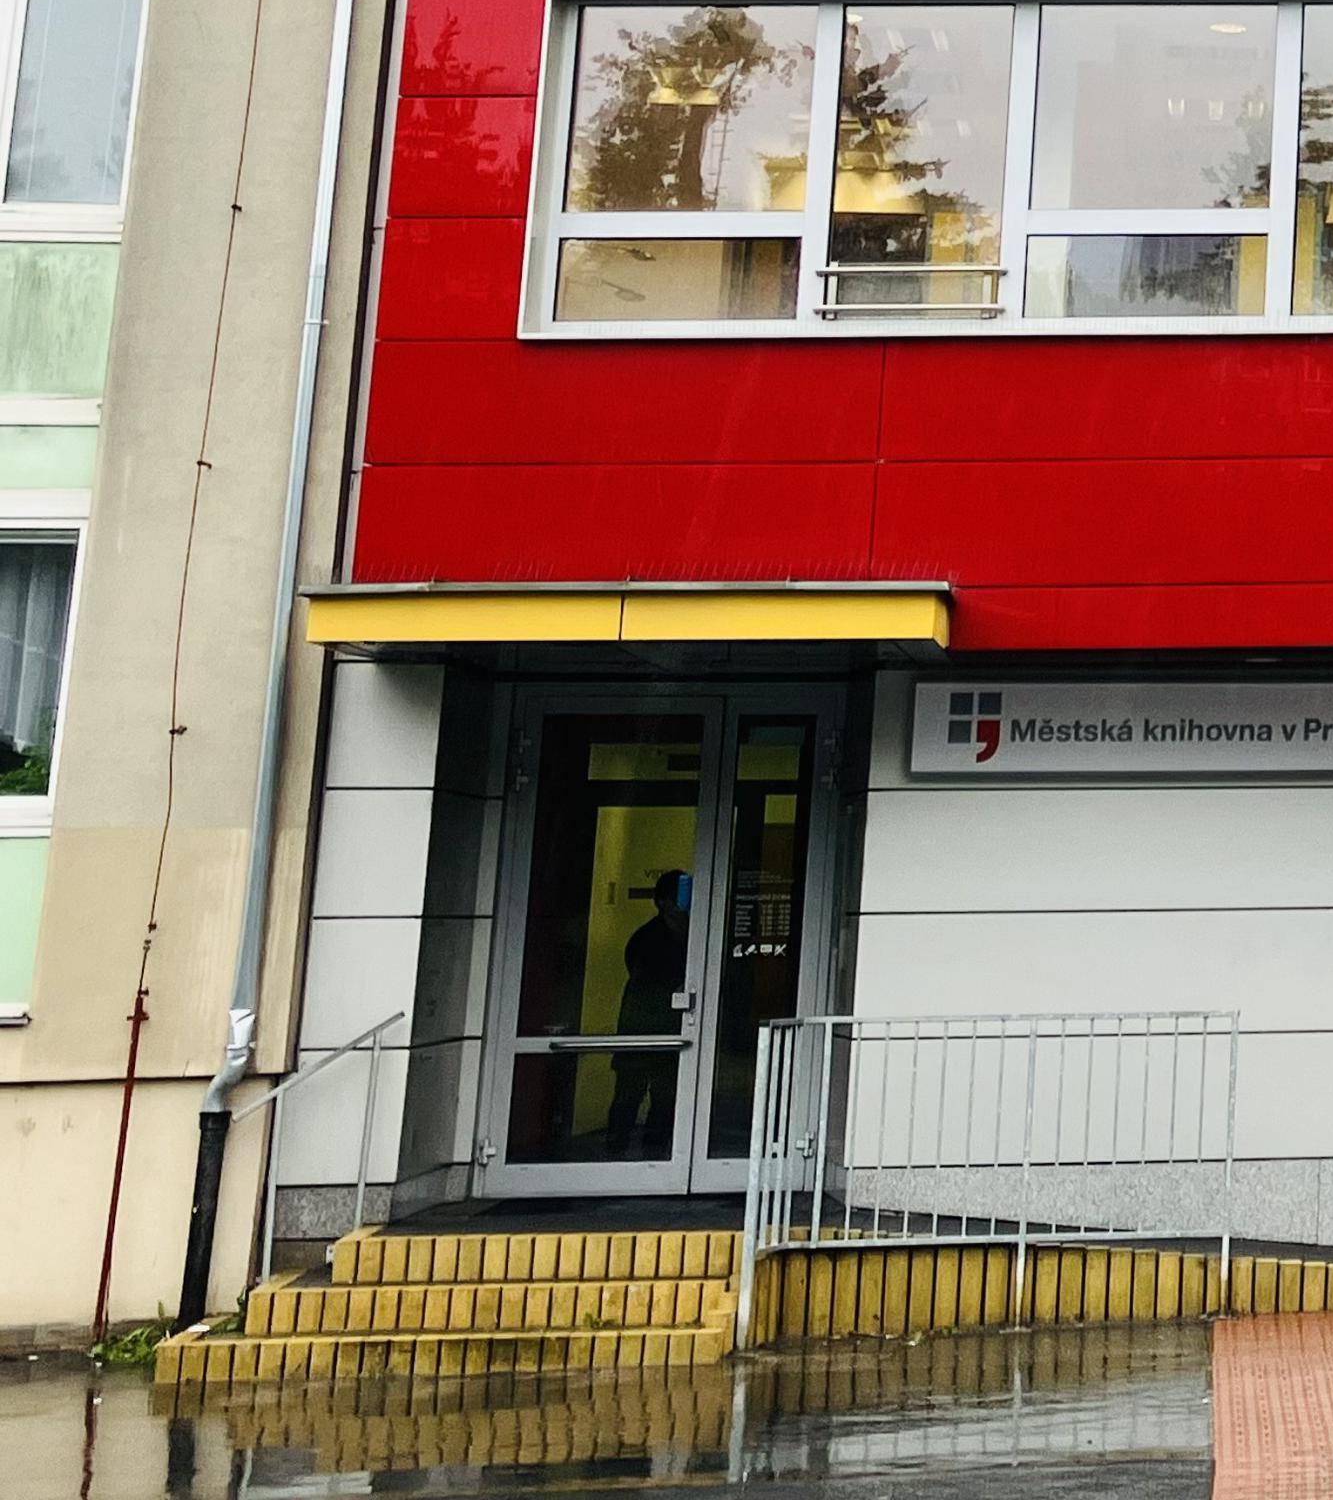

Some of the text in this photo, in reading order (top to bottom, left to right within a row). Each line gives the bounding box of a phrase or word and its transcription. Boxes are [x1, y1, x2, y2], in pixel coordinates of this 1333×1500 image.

[1009, 714, 1134, 745] Městská
[1143, 714, 1273, 743] knihovna
[1282, 720, 1299, 742] v
